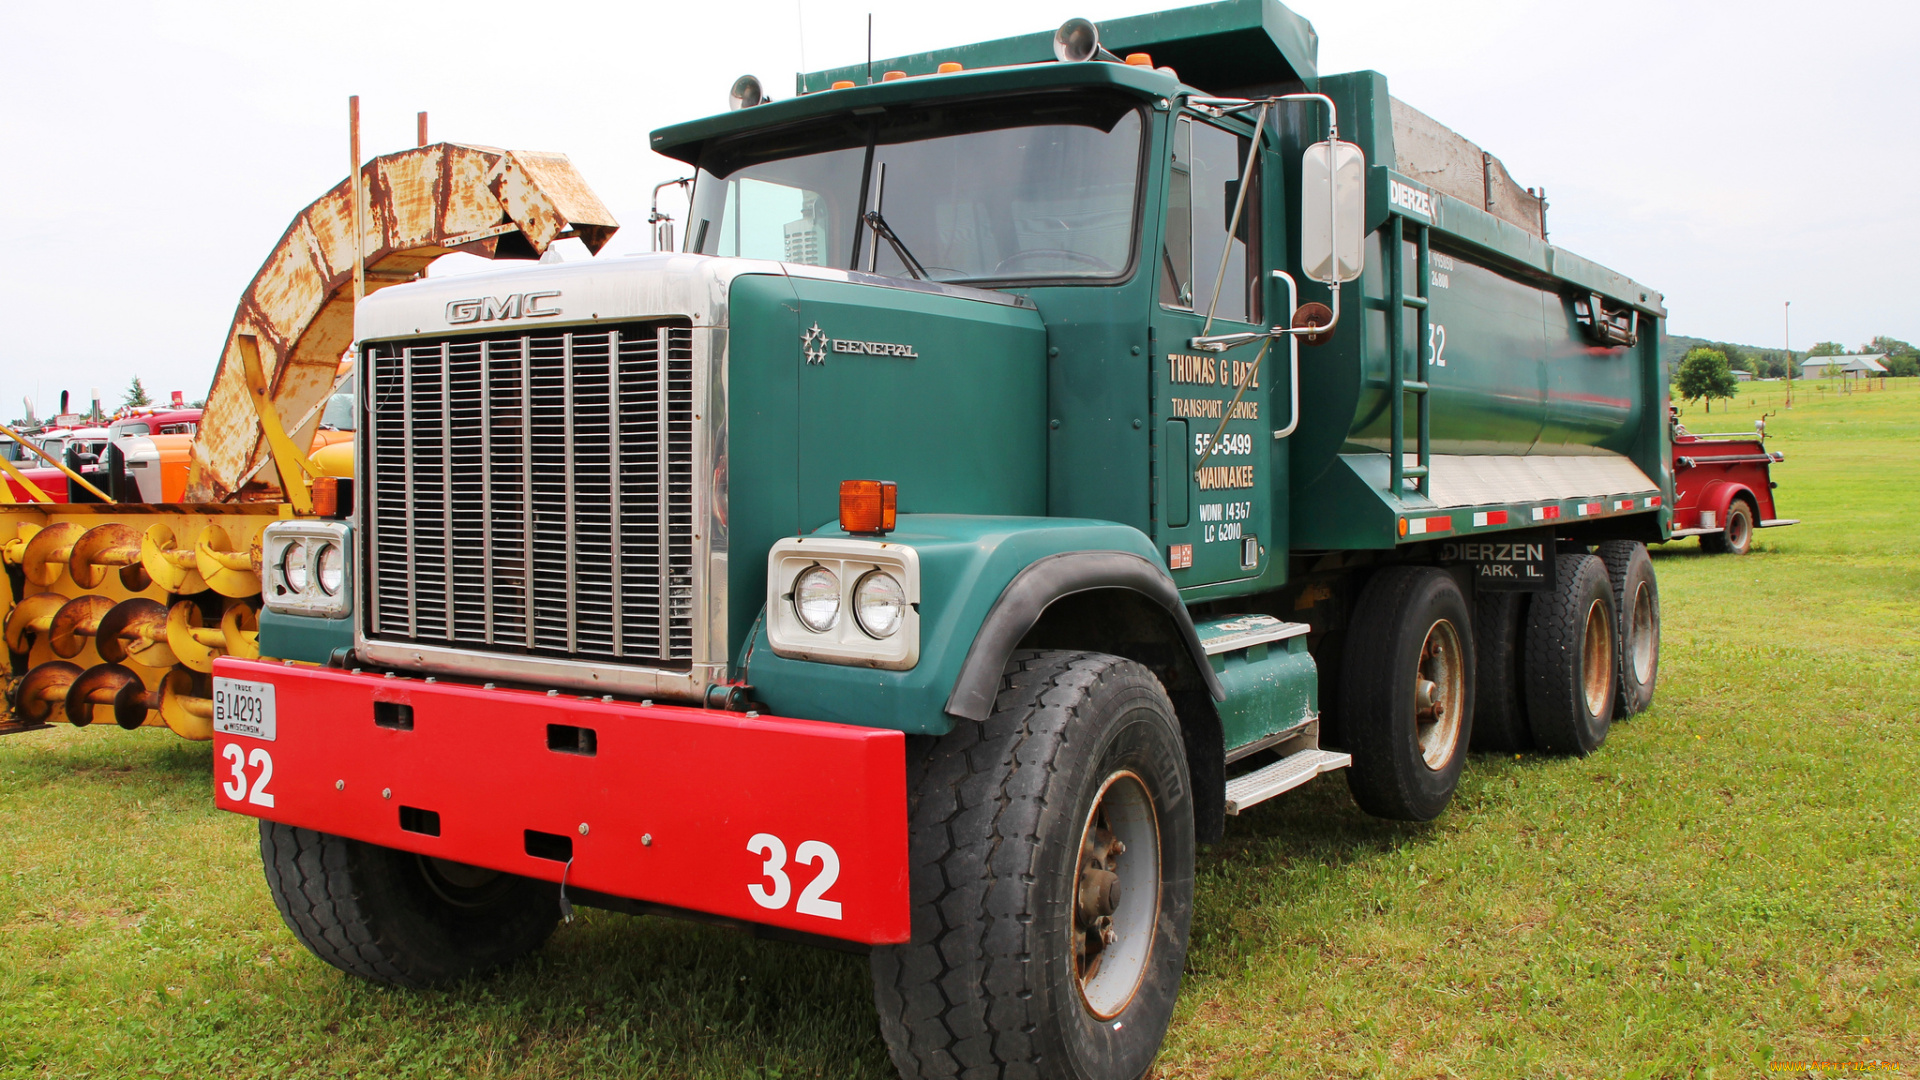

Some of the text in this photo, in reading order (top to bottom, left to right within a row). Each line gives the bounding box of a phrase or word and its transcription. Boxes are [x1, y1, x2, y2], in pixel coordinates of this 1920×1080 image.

[445, 290, 562, 324] GMC
[832, 339, 919, 358] GENERAL
[1428, 323, 1446, 367] 32
[1167, 354, 1216, 385] THOMAS
[1220, 359, 1228, 386] G
[1171, 398, 1222, 419] TRANSPORT
[1199, 465, 1254, 490] WAUNAKEE
[1199, 501, 1251, 522] WDNR 14367
[1204, 523, 1241, 543] LC 62010
[1441, 543, 1544, 561] DIERZEN
[1476, 564, 1544, 578] ARK, IL.
[234, 684, 252, 692] TRUCK
[227, 693, 262, 724] 14293
[229, 723, 260, 733] WISCONSIN
[222, 743, 275, 808] 32
[746, 832, 842, 920] 32
